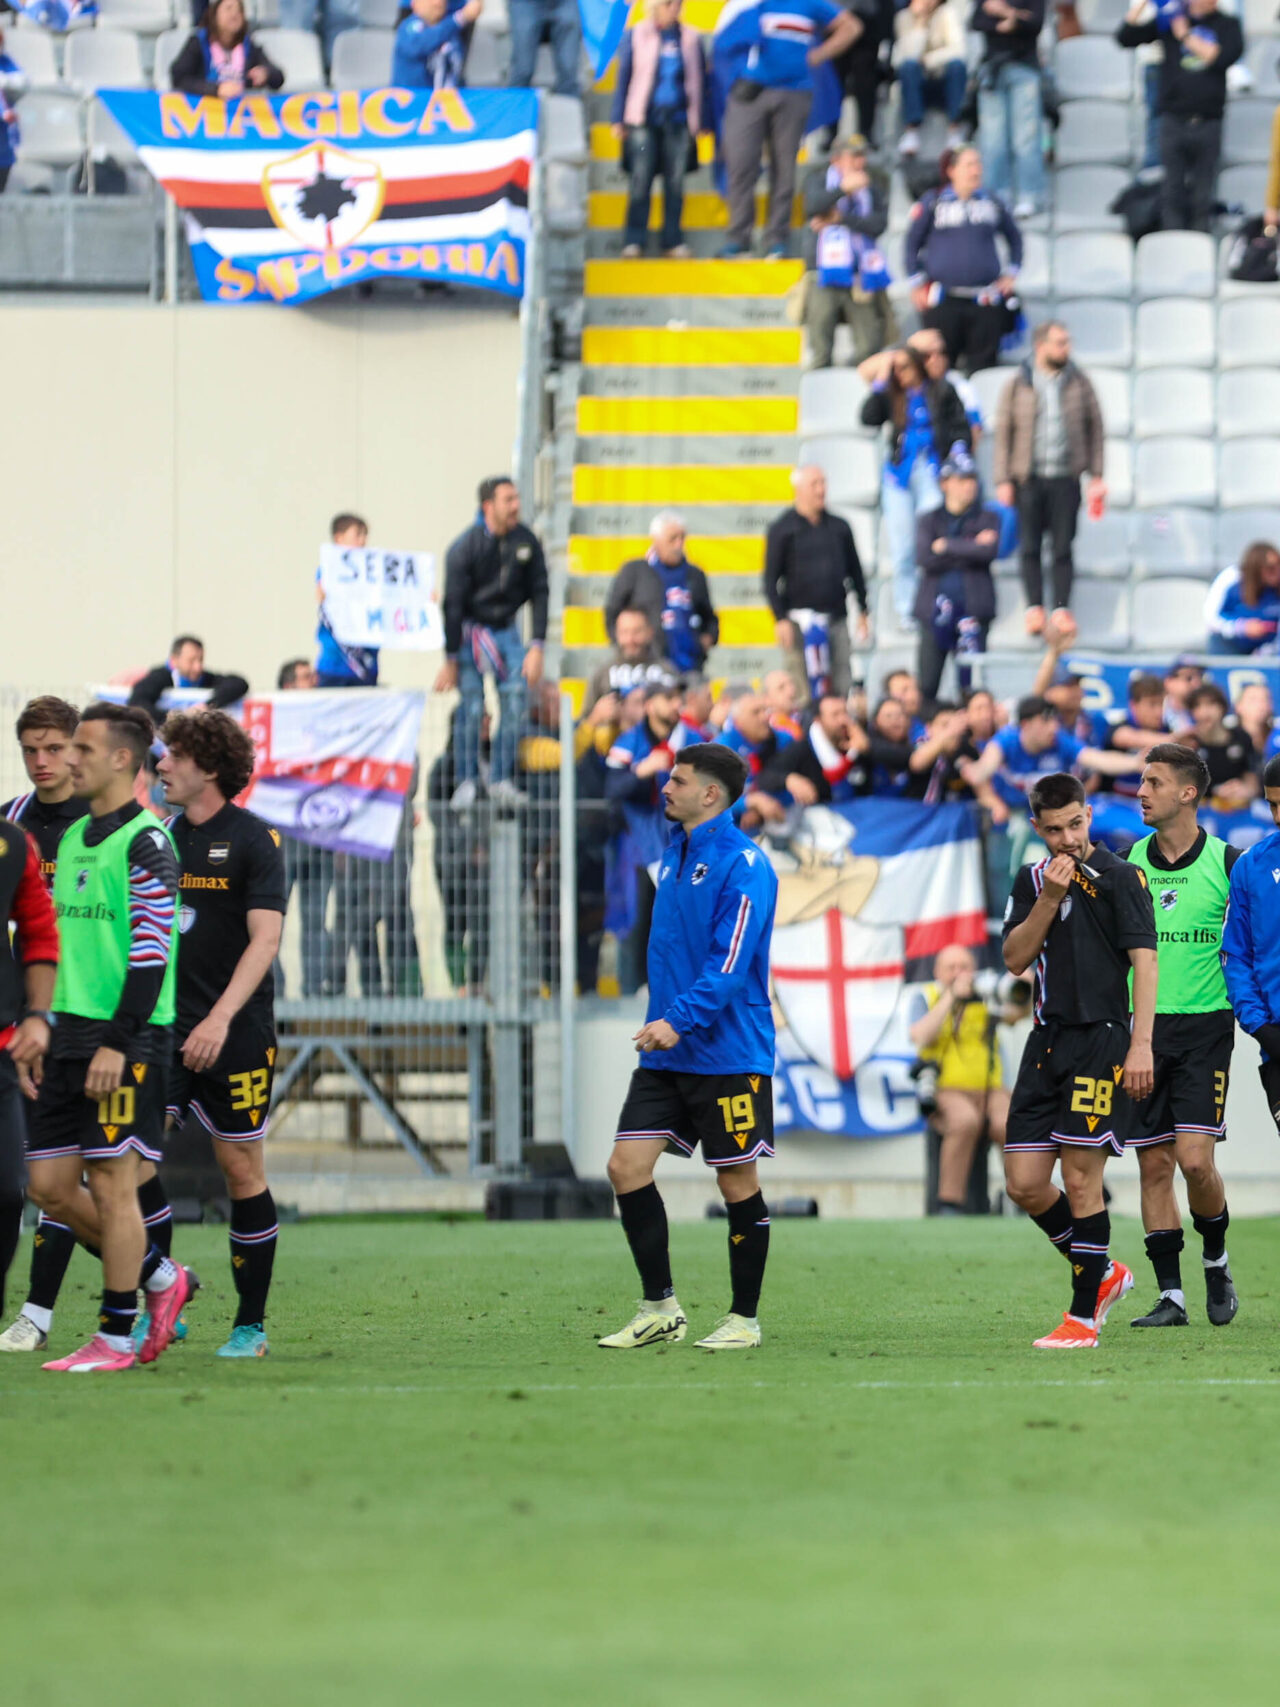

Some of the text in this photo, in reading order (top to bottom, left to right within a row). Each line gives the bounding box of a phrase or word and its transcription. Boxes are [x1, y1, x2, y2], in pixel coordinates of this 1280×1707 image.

[159, 88, 474, 138] MAGICA
[338, 551, 419, 588] SEBA
[1150, 876, 1189, 885] macron
[1193, 928, 1218, 943] Ifis
[98, 1086, 135, 1124] 10
[228, 1067, 268, 1110] 32
[1071, 1076, 1114, 1117] 28
[717, 1093, 756, 1133] 19
